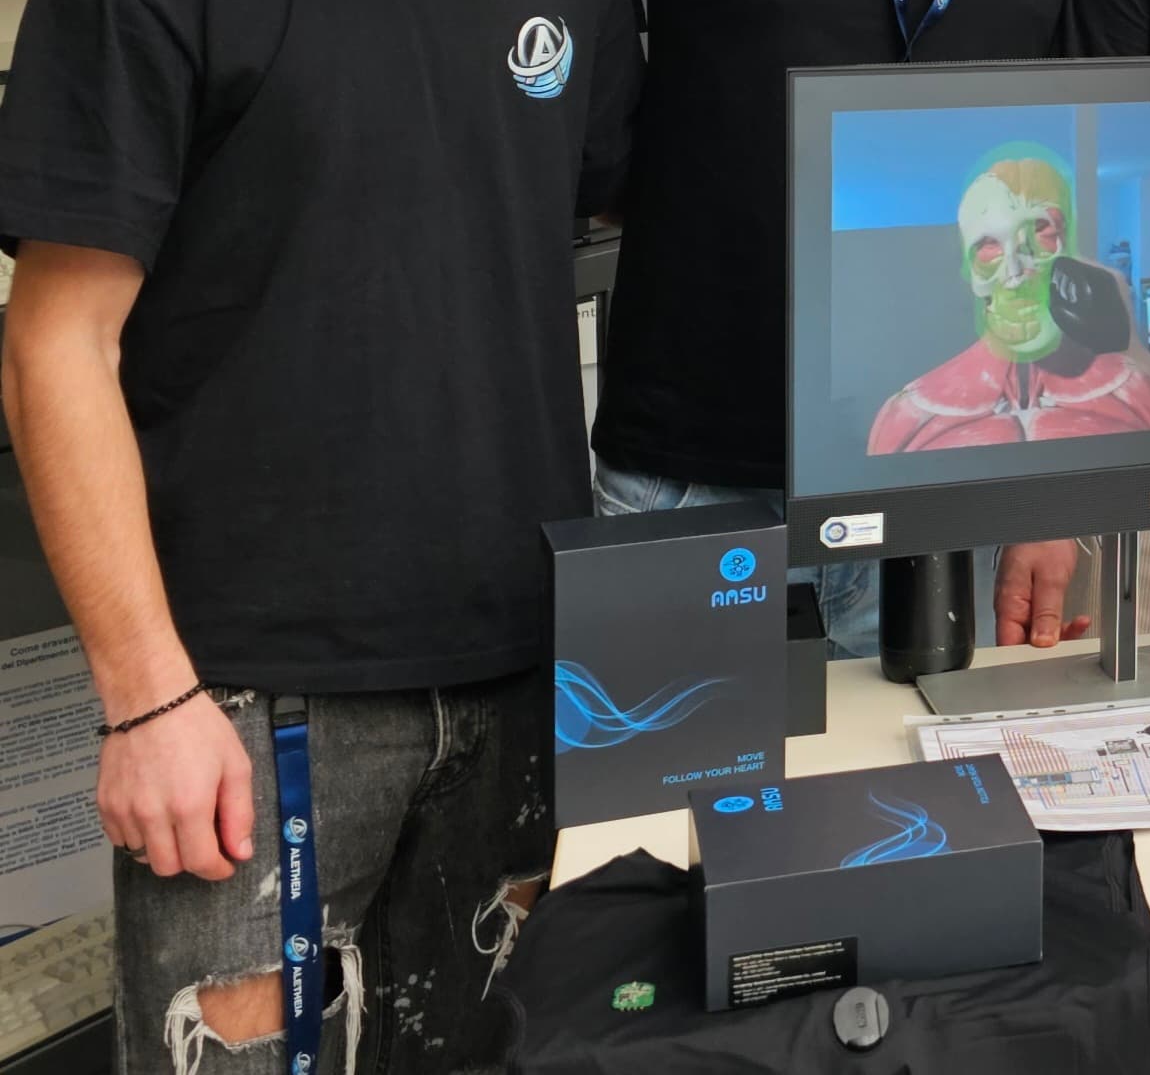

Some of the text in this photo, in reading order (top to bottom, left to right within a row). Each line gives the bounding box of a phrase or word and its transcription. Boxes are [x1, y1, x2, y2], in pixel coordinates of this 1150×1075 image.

[10, 643, 40, 656] Come
[737, 751, 765, 763] MOVE
[662, 761, 766, 785] FOLLOW YOUR HEART
[290, 847, 301, 901] ALETHEIA
[292, 965, 304, 1019] ALETHEIA
